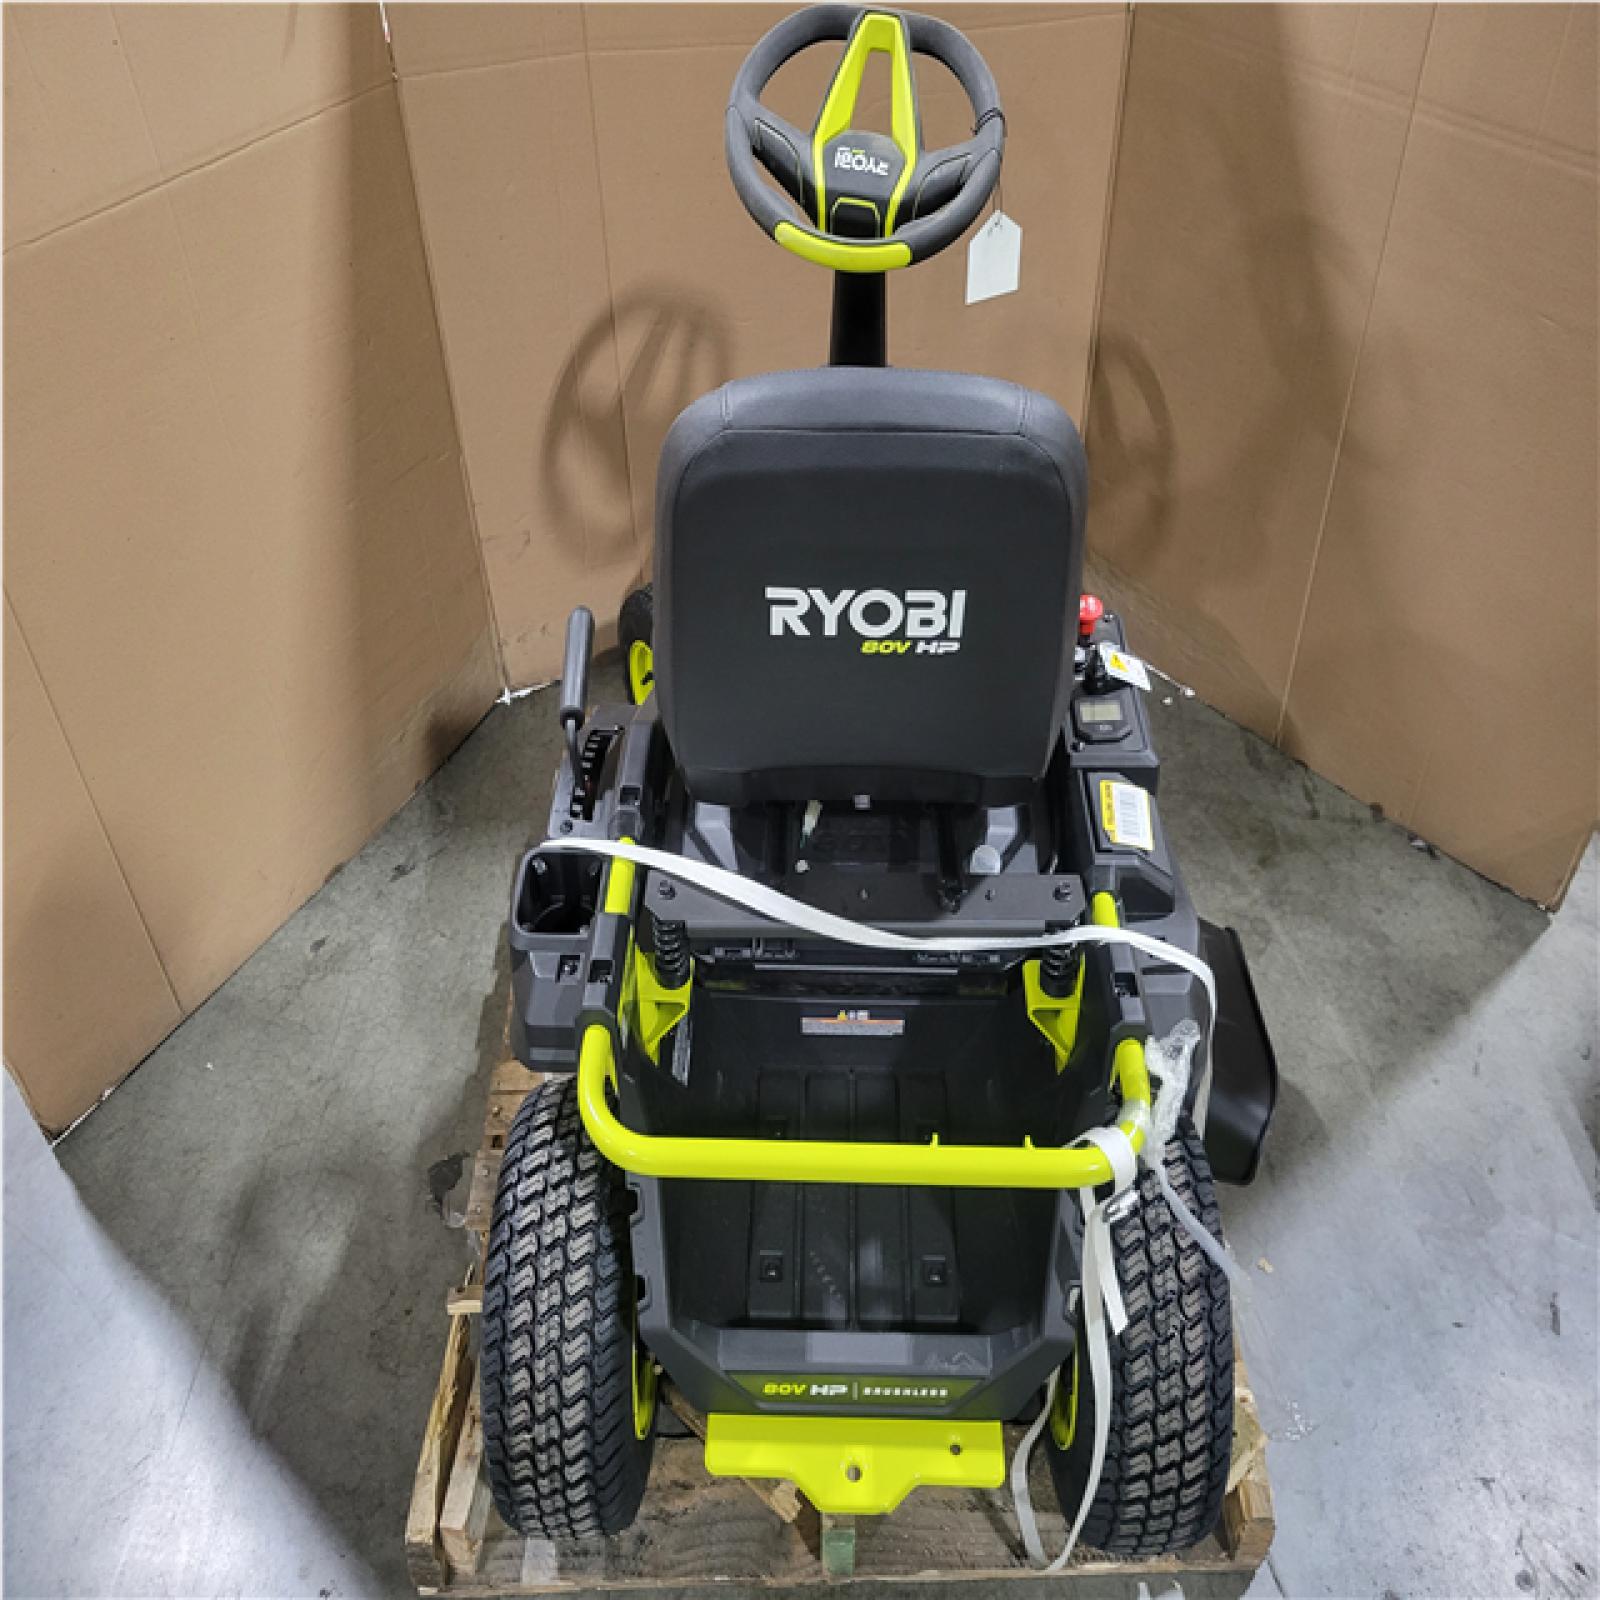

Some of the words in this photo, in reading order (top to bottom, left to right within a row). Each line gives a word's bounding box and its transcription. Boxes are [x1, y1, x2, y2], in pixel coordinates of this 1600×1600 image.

[764, 586, 967, 639] RYOBI
[860, 639, 912, 655] 80V
[914, 640, 961, 655] HP
[762, 1383, 808, 1396] 80V
[809, 1383, 849, 1396] HP
